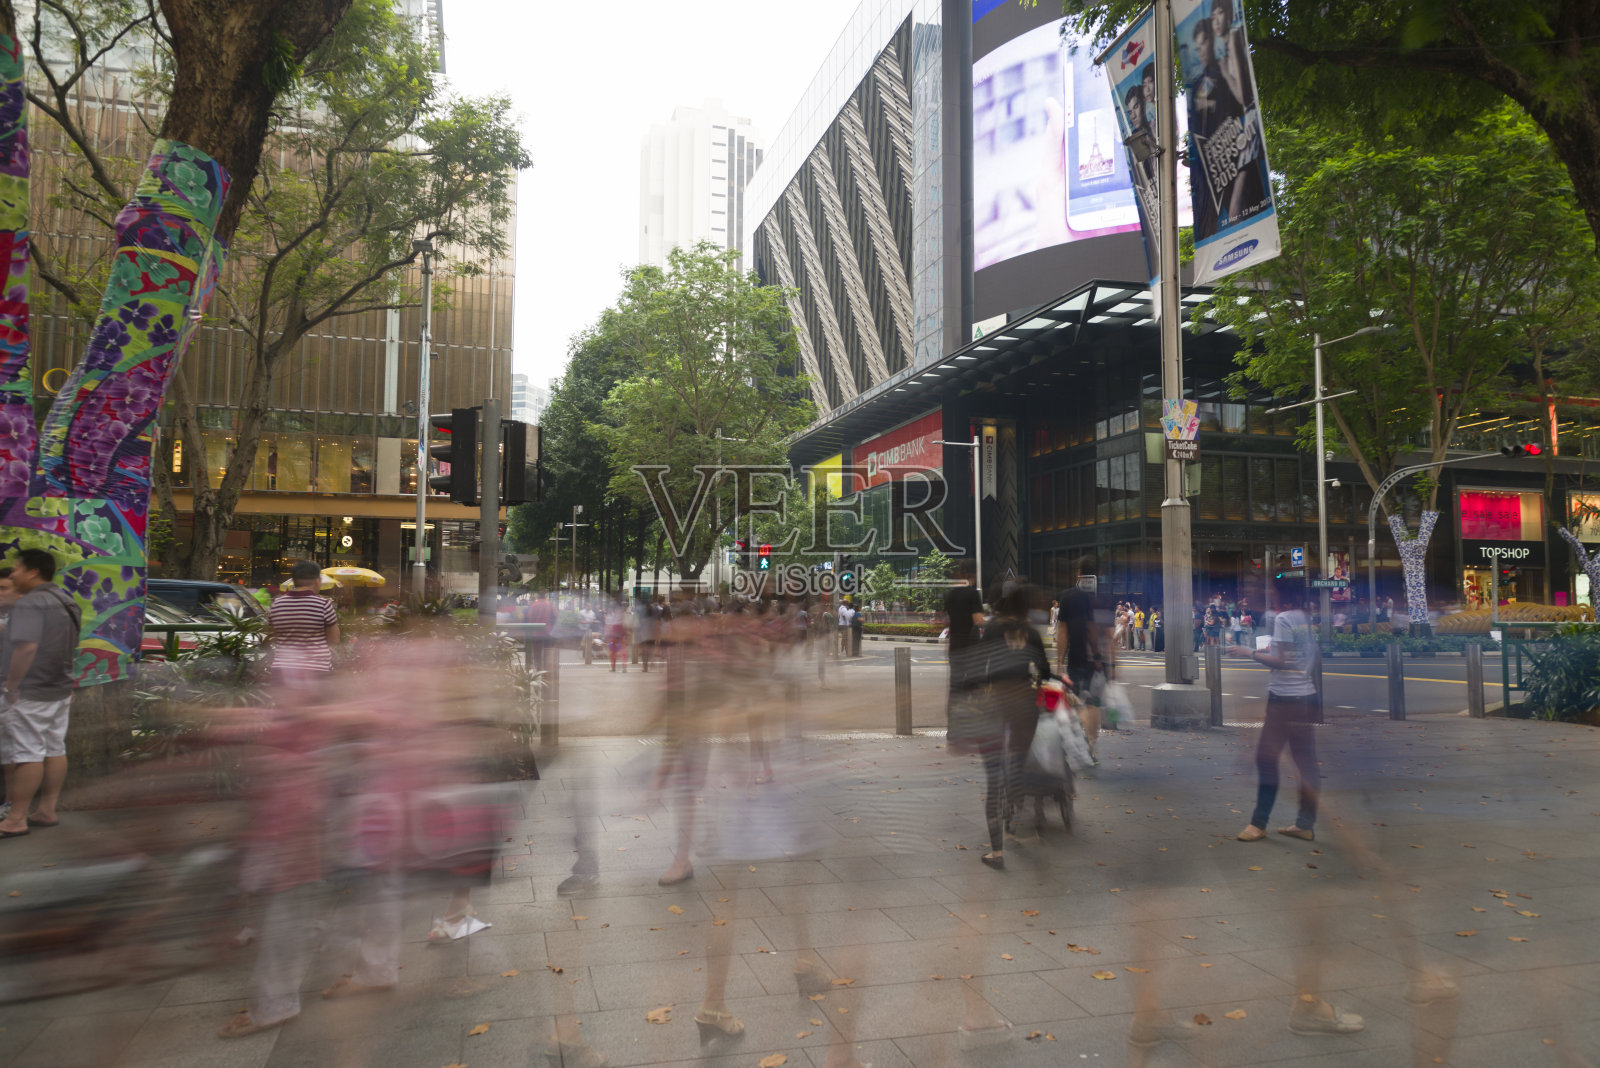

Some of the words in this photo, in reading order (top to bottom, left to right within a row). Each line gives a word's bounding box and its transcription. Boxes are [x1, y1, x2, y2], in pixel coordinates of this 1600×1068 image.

[1205, 116, 1243, 165] FASHION
[1209, 142, 1239, 178] STEPS
[1214, 162, 1238, 193] 2013
[1242, 208, 1249, 217] 12
[1249, 204, 1260, 213] May
[1218, 245, 1255, 265] SAMSUNG
[878, 446, 900, 469] CIMB
[900, 436, 925, 462] BANK
[1473, 509, 1493, 520] sale
[1479, 547, 1530, 559] TOPSHOP
